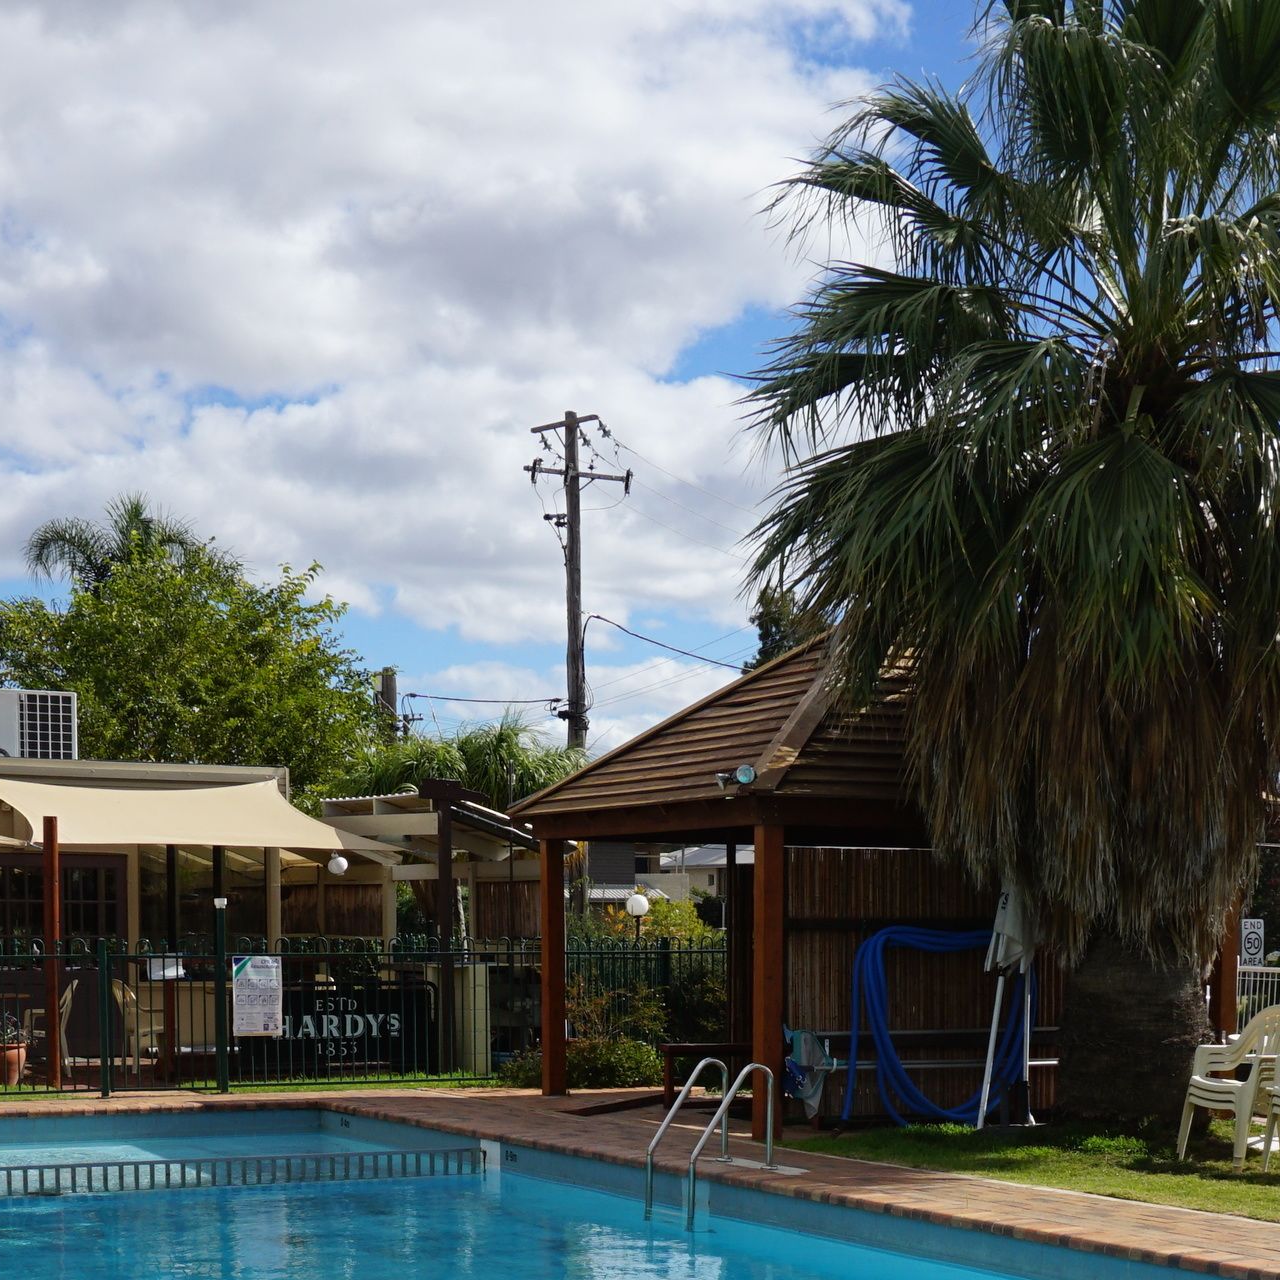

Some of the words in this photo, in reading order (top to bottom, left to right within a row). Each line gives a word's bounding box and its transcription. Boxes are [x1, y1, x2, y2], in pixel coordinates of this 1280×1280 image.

[1243, 920, 1262, 930] END
[1246, 937, 1260, 950] 50
[1243, 957, 1263, 966] AREA
[316, 997, 358, 1011] ESTD
[317, 1041, 358, 1057] 1853
